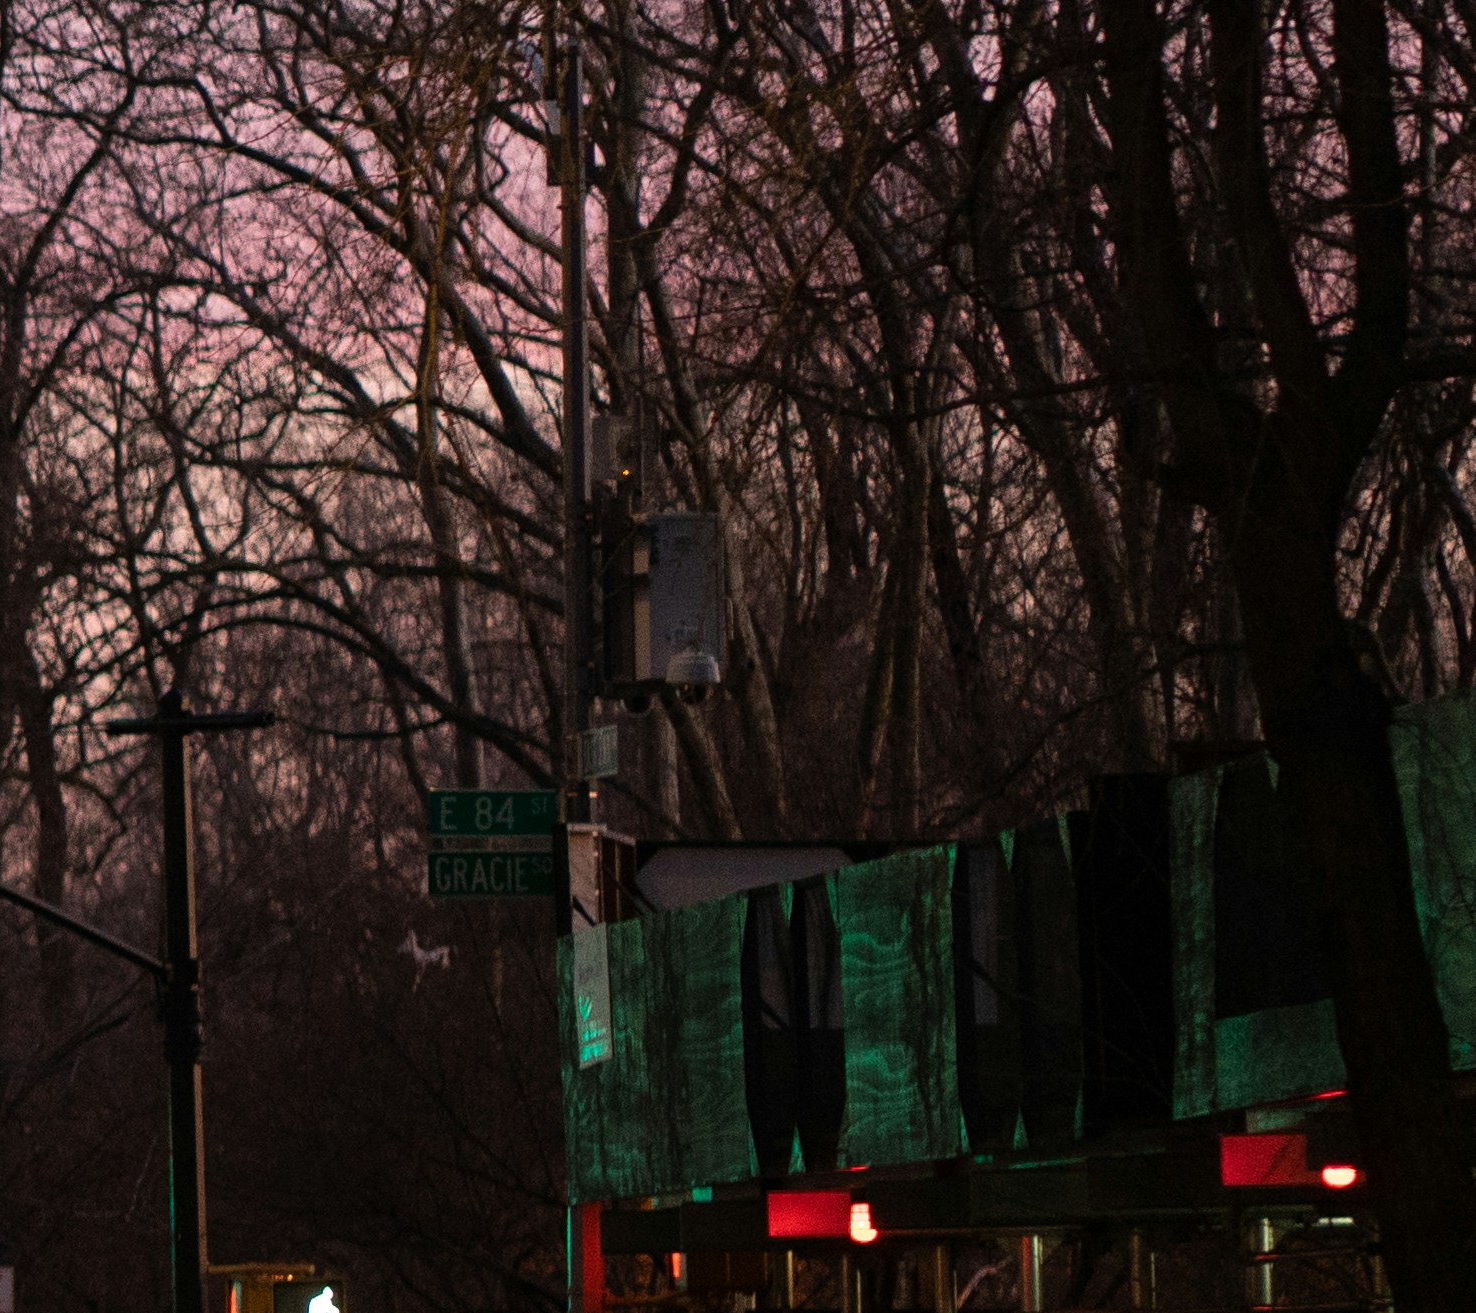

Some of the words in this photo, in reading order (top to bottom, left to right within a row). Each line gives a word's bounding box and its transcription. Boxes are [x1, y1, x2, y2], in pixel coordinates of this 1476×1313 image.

[440, 796, 457, 831] E
[475, 796, 515, 831] 84
[531, 796, 548, 814] ST
[435, 856, 529, 892] GRACIE
